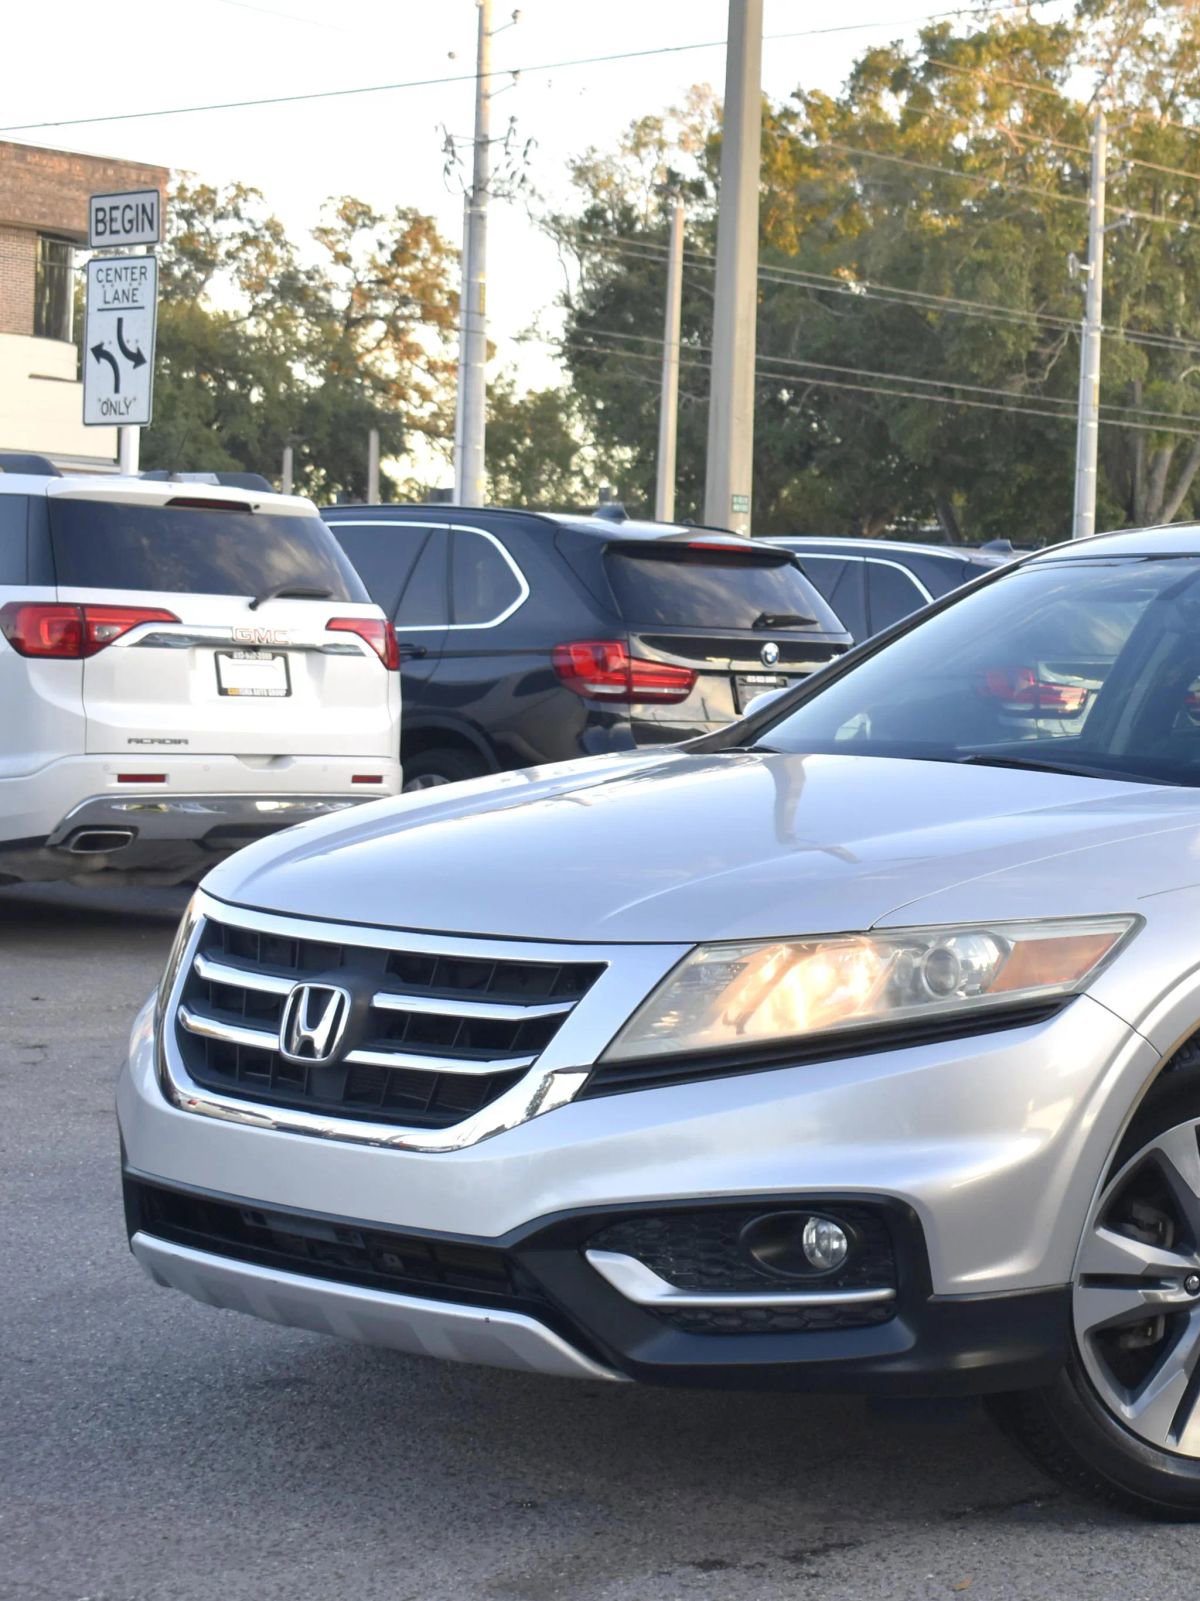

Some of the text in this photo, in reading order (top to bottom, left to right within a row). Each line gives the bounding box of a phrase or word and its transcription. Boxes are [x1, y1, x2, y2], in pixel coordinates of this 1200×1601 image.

[95, 202, 154, 236] BEGIN
[96, 265, 148, 284] CENTER
[104, 288, 139, 304] LANE
[101, 400, 133, 416] ONLY
[232, 626, 289, 645] GMC
